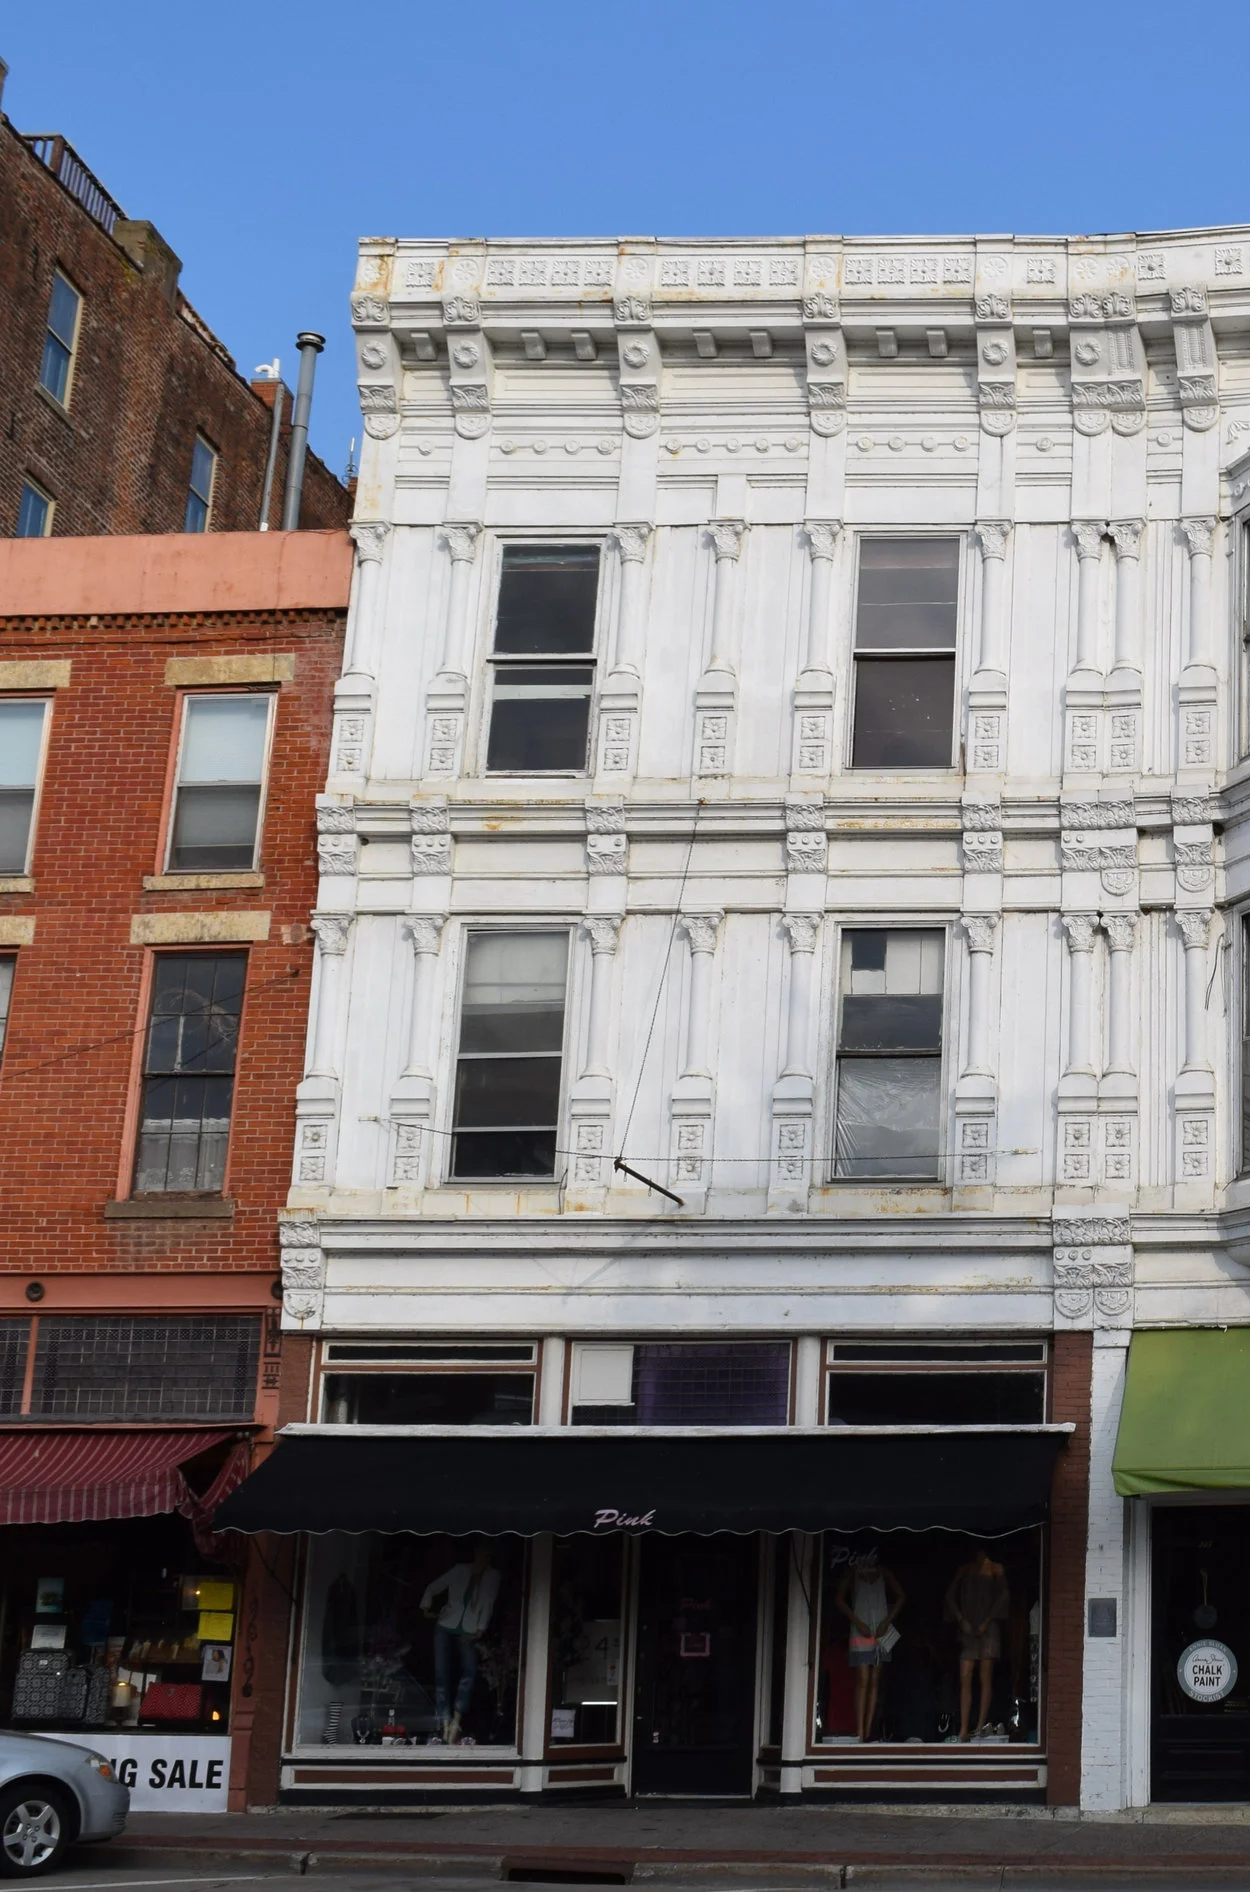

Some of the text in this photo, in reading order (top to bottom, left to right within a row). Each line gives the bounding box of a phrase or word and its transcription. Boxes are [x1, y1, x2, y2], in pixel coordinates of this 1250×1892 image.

[593, 1508, 657, 1529] Pink
[1192, 1664, 1222, 1675] CHALK
[1193, 1676, 1221, 1686] PAINT
[1189, 1690, 1225, 1702] STOCKIST
[149, 1758, 224, 1789] SALE
